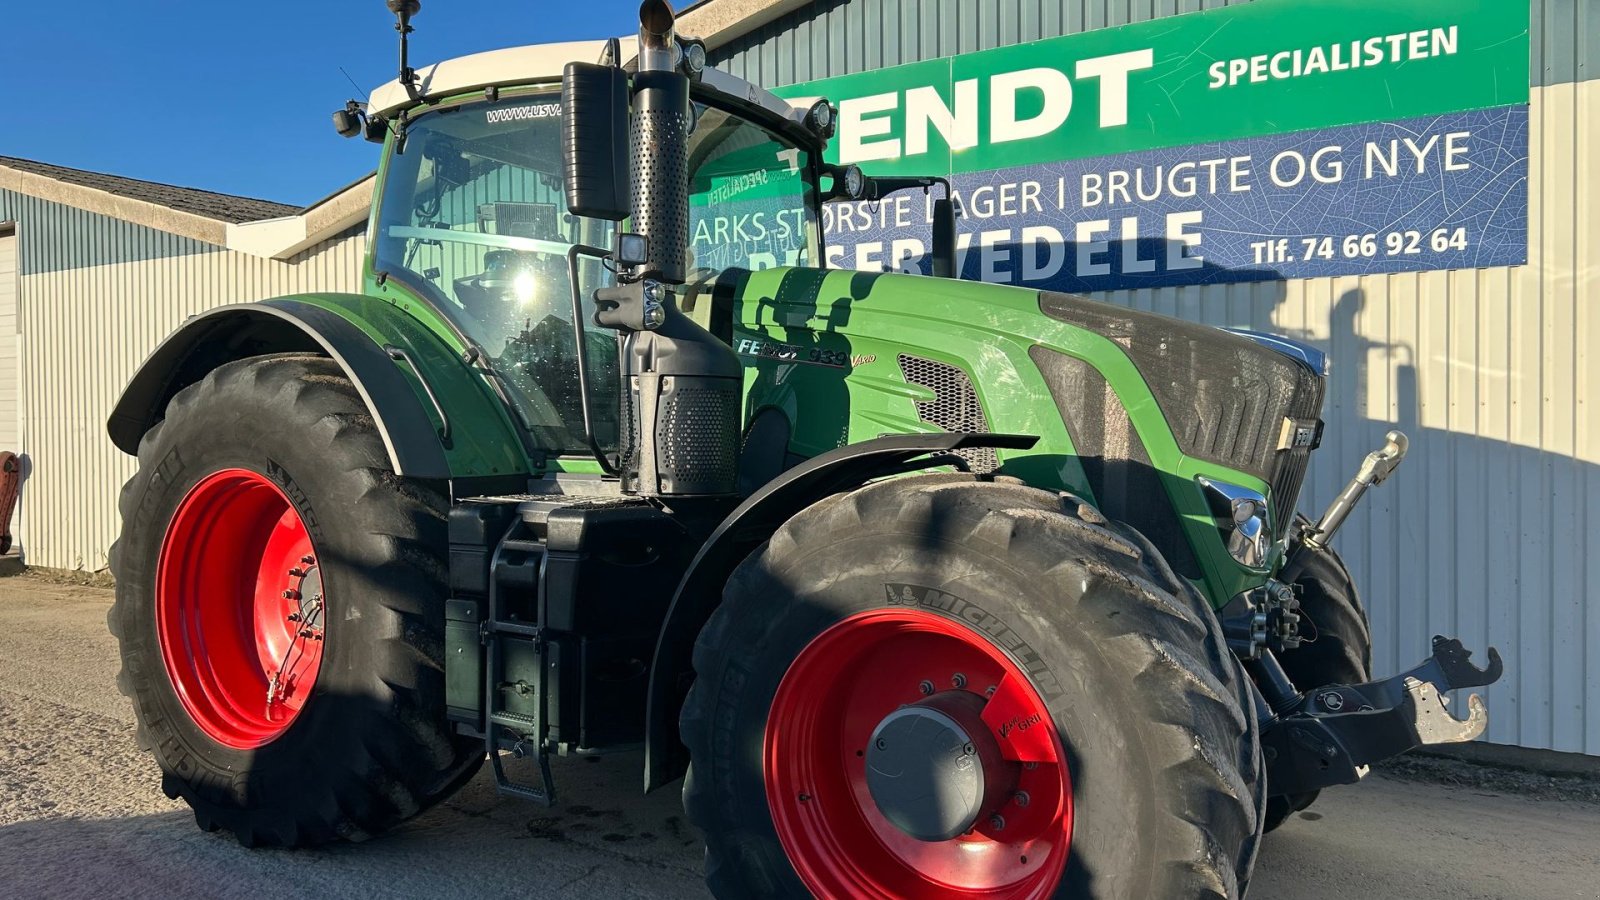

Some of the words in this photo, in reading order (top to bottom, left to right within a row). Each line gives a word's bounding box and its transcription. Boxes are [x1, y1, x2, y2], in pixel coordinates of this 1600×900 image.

[1209, 25, 1458, 89] SPECIALISTEN
[486, 103, 562, 123] www.usv.
[784, 47, 1153, 164] ENDT
[691, 212, 767, 247] ARKS
[1058, 177, 1066, 209] I
[1081, 155, 1251, 208] BRUGTE
[1270, 145, 1343, 188] OG
[1365, 131, 1471, 180] NYE
[1251, 238, 1293, 264] Tlf.
[1302, 237, 1334, 261] 74
[1342, 233, 1377, 259] 66
[1386, 230, 1421, 256] 92
[1431, 227, 1468, 253] 64
[922, 589, 1066, 700] MICHELIN
[1017, 713, 1042, 731] GRI
